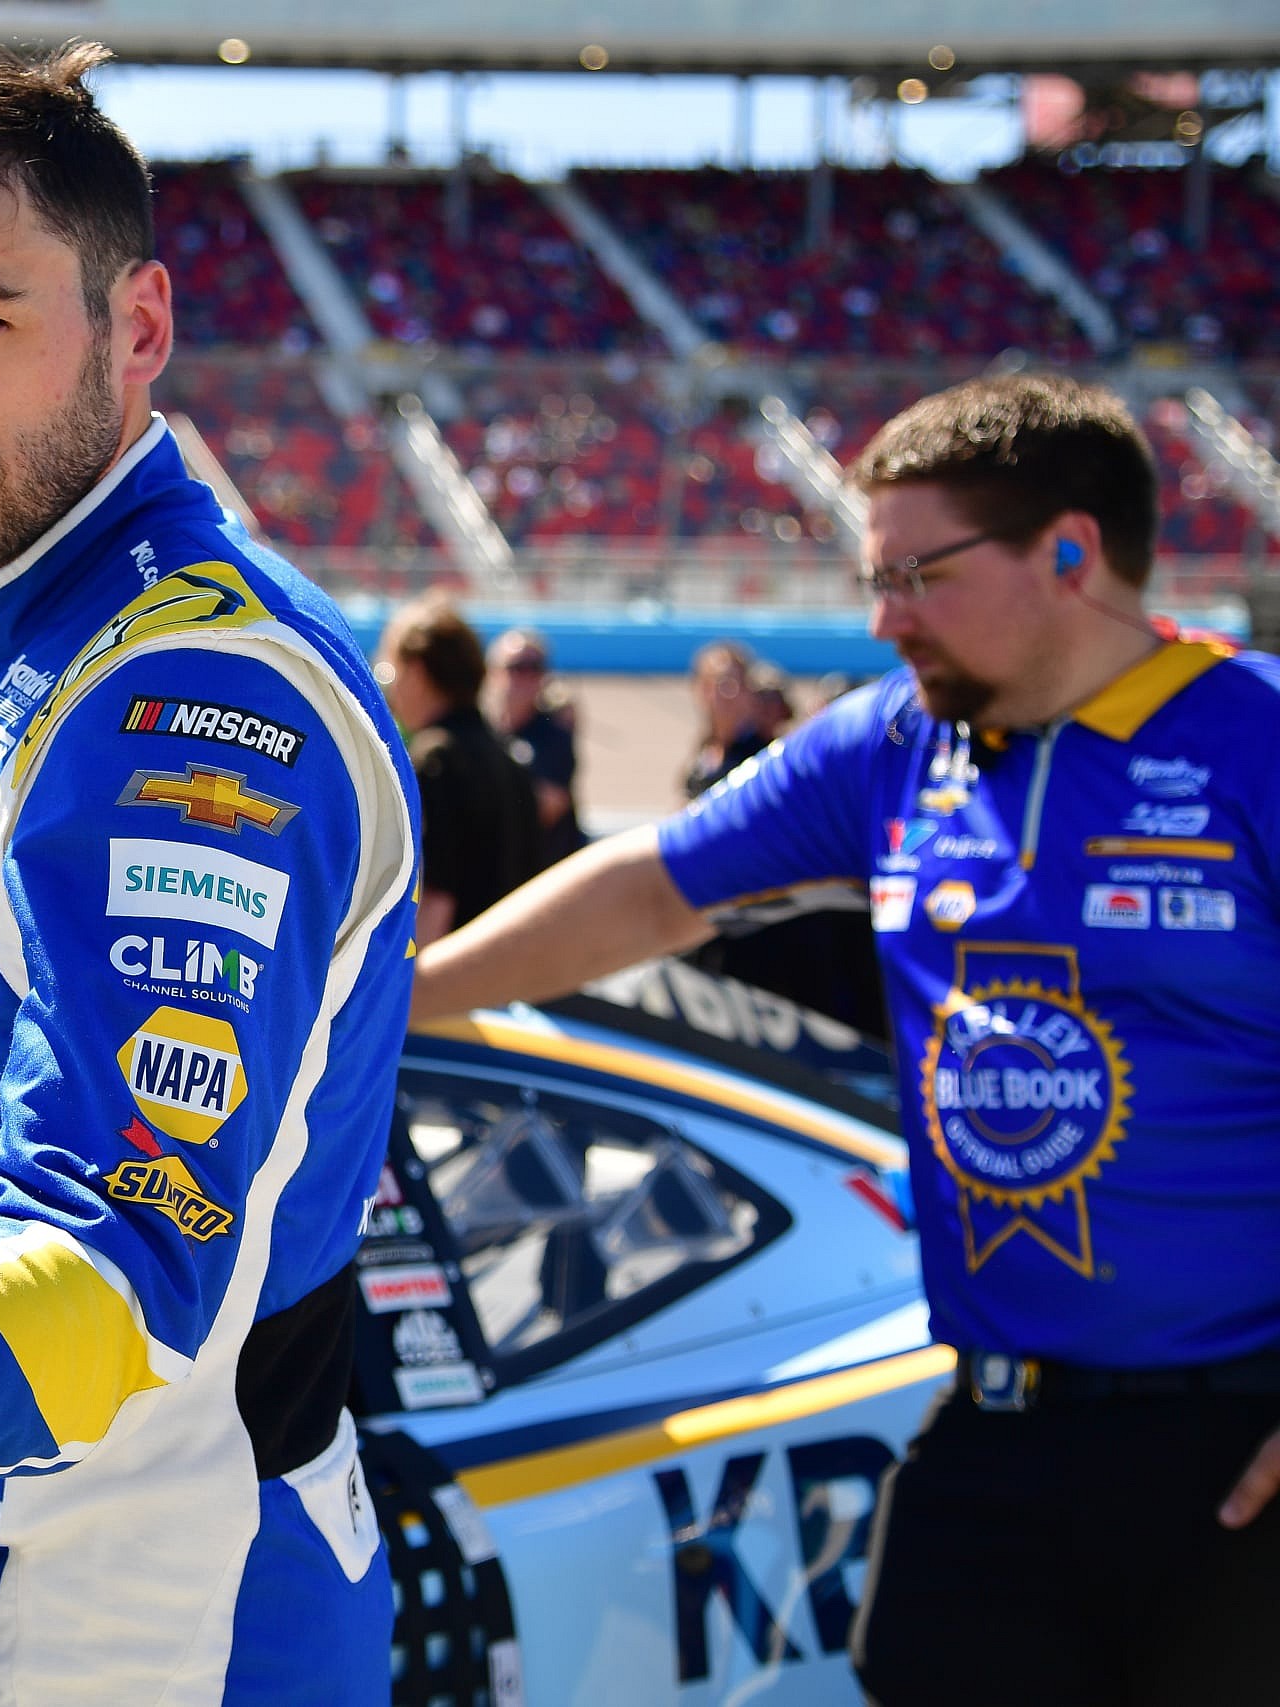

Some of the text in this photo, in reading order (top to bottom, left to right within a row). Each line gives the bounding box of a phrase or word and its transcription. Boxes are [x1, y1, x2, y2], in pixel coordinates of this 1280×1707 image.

[169, 703, 296, 763] NASCAR
[125, 864, 268, 919] SIEMENS
[109, 934, 259, 1000] CLIMB
[122, 978, 251, 1014] CHANNEL SOLUTIONS
[135, 1039, 229, 1112] NAPA
[934, 1067, 1103, 1111] BLUE BOOK
